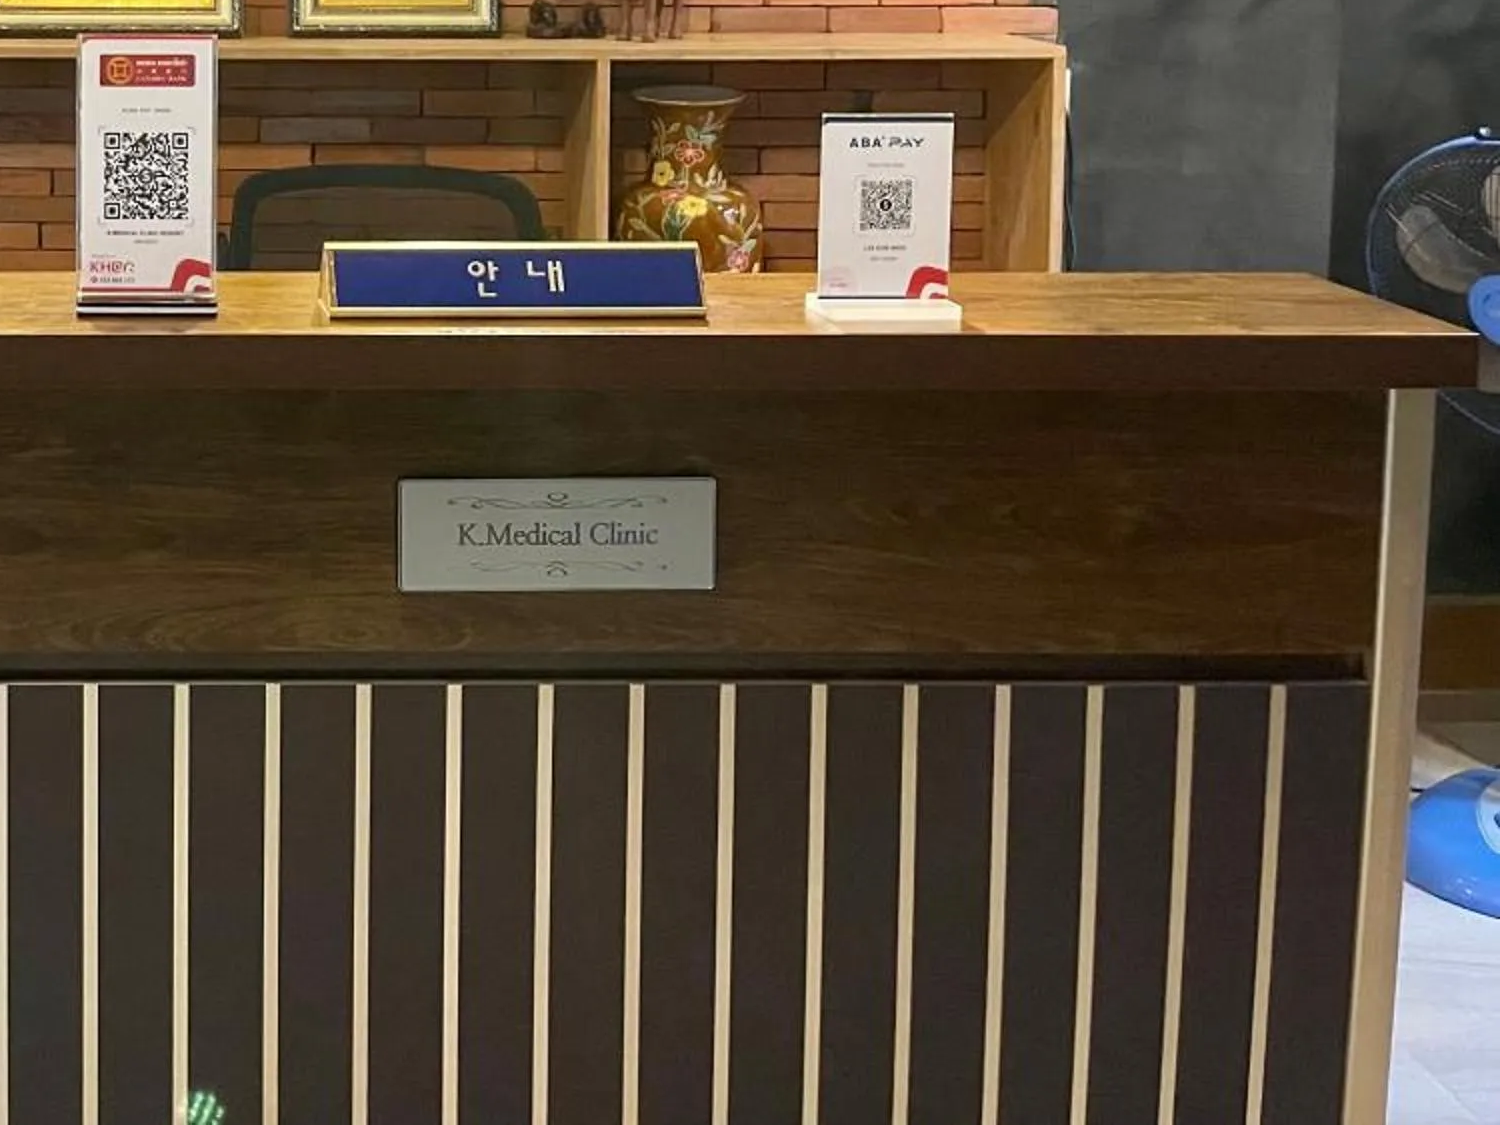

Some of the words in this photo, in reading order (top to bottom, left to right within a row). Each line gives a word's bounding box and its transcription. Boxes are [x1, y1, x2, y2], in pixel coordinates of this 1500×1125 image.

[849, 136, 882, 148] ABA
[467, 259, 499, 298] 안
[527, 260, 565, 292] 내
[457, 522, 581, 547] K.Medical
[589, 522, 659, 546] Clinic
